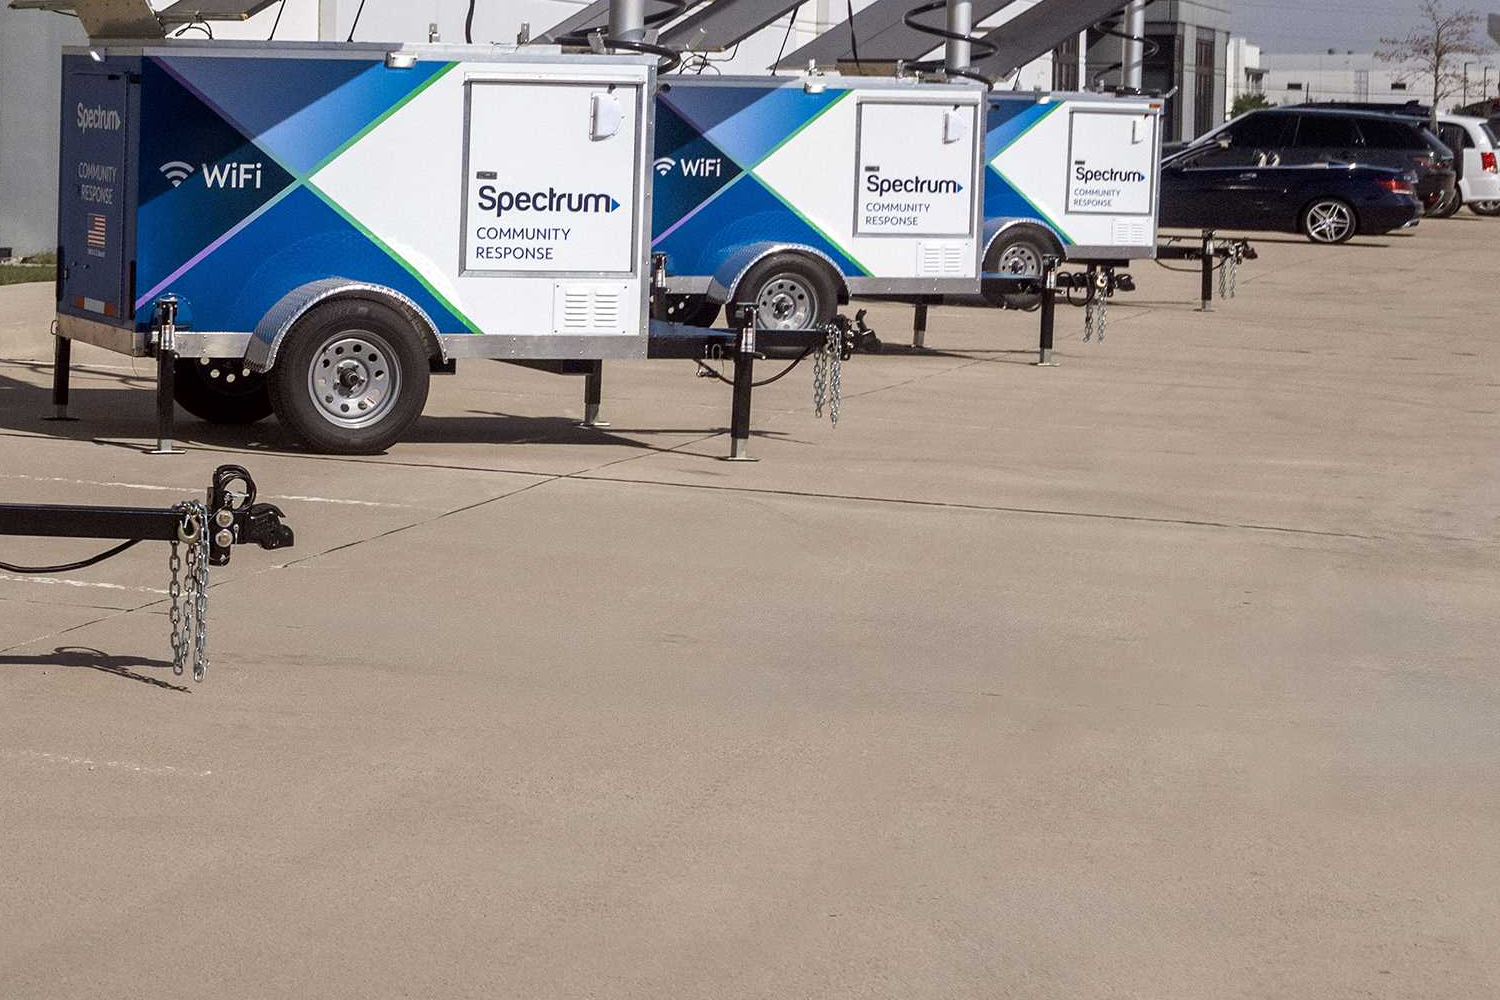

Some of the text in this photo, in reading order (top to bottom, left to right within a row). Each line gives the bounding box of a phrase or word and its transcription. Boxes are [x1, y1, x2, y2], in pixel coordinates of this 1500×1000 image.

[77, 102, 117, 134] Spectrum
[78, 162, 117, 185] COMMUNITY
[202, 162, 262, 189] WiFi
[680, 158, 721, 177] WiFi
[1076, 167, 1140, 183] Spectrum
[865, 174, 956, 197] Spectrum
[1074, 187, 1121, 197] COMMUNITY
[81, 184, 113, 205] RESPONSE
[478, 185, 610, 217] Spectrum
[1073, 198, 1112, 207] RESPONSE
[866, 202, 931, 213] COMMUNITY
[865, 215, 919, 226] RESPONSE
[476, 226, 571, 241] COMMUNITY
[476, 246, 554, 260] RESPONSE
